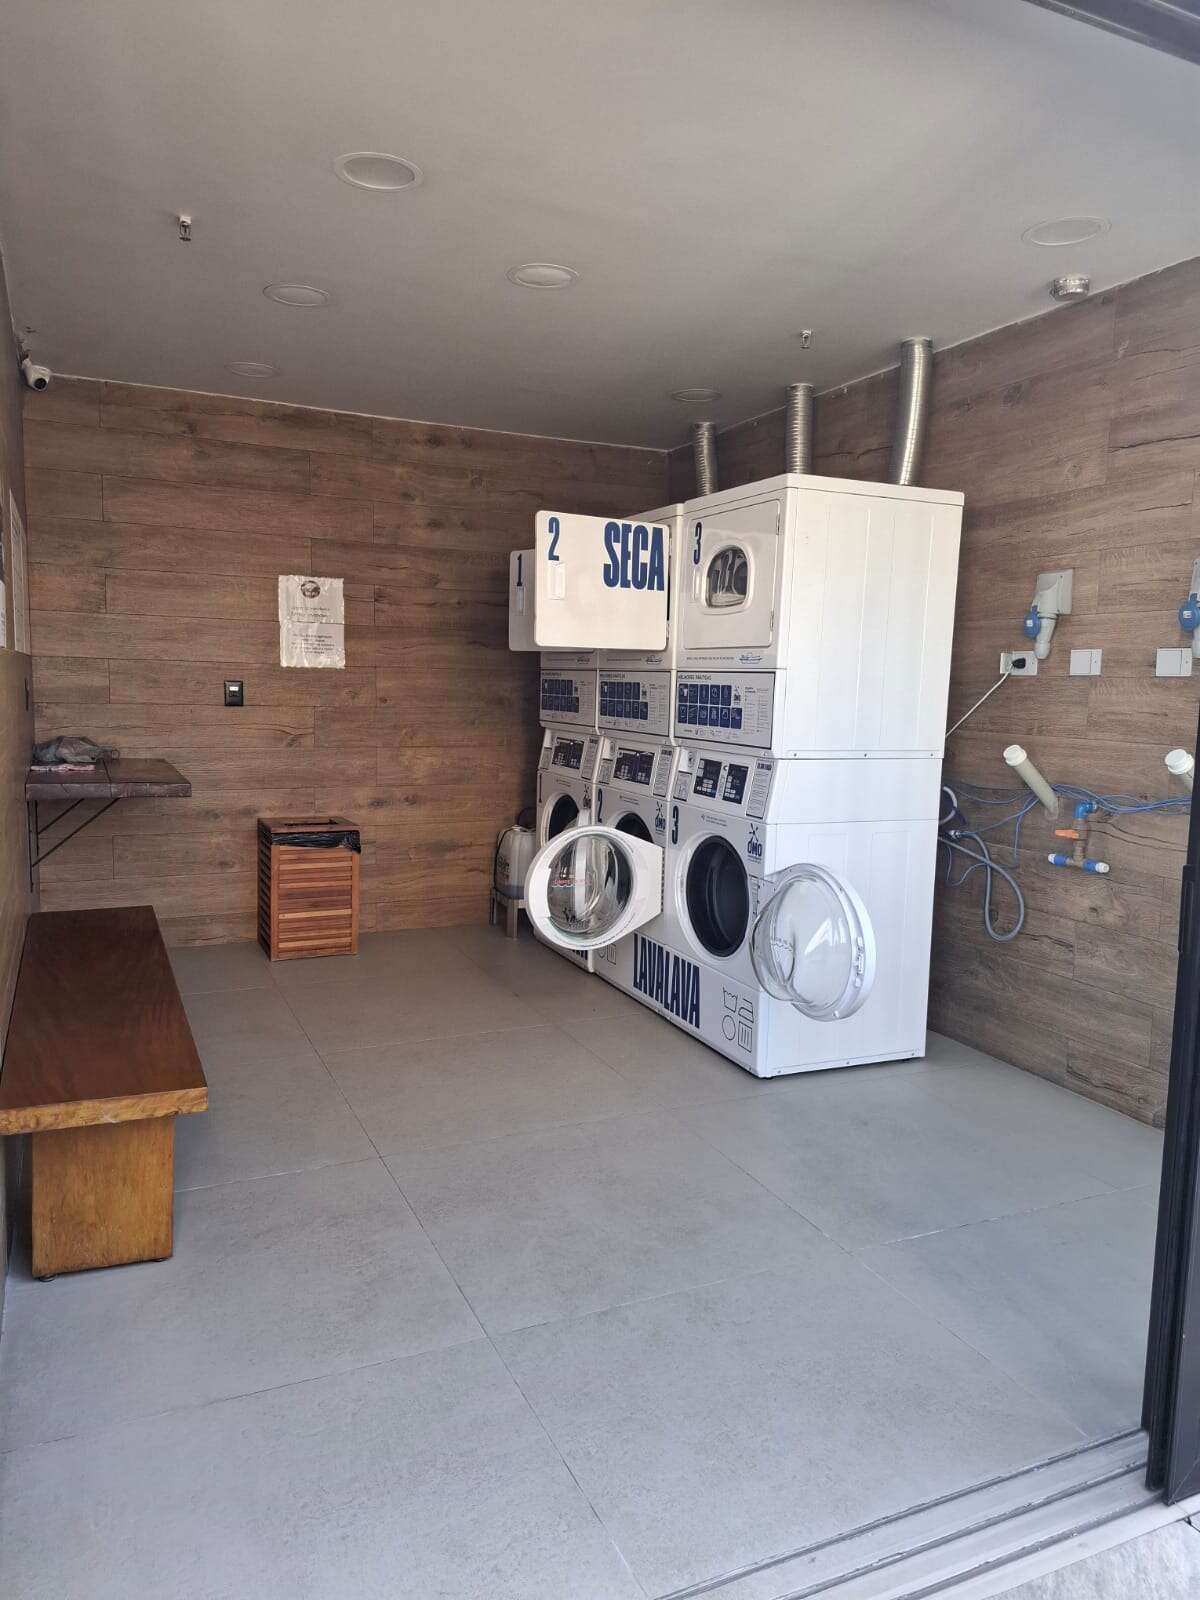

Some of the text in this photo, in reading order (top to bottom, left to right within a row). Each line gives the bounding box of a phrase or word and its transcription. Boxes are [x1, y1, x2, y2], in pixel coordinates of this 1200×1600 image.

[548, 516, 560, 561] 2
[603, 521, 665, 592] SECA
[693, 522, 702, 565] 3
[515, 553, 524, 587] 1
[597, 788, 603, 824] 2
[671, 805, 680, 845] 3
[747, 840, 762, 857] OMO
[633, 932, 700, 1029] LAVALAVA
